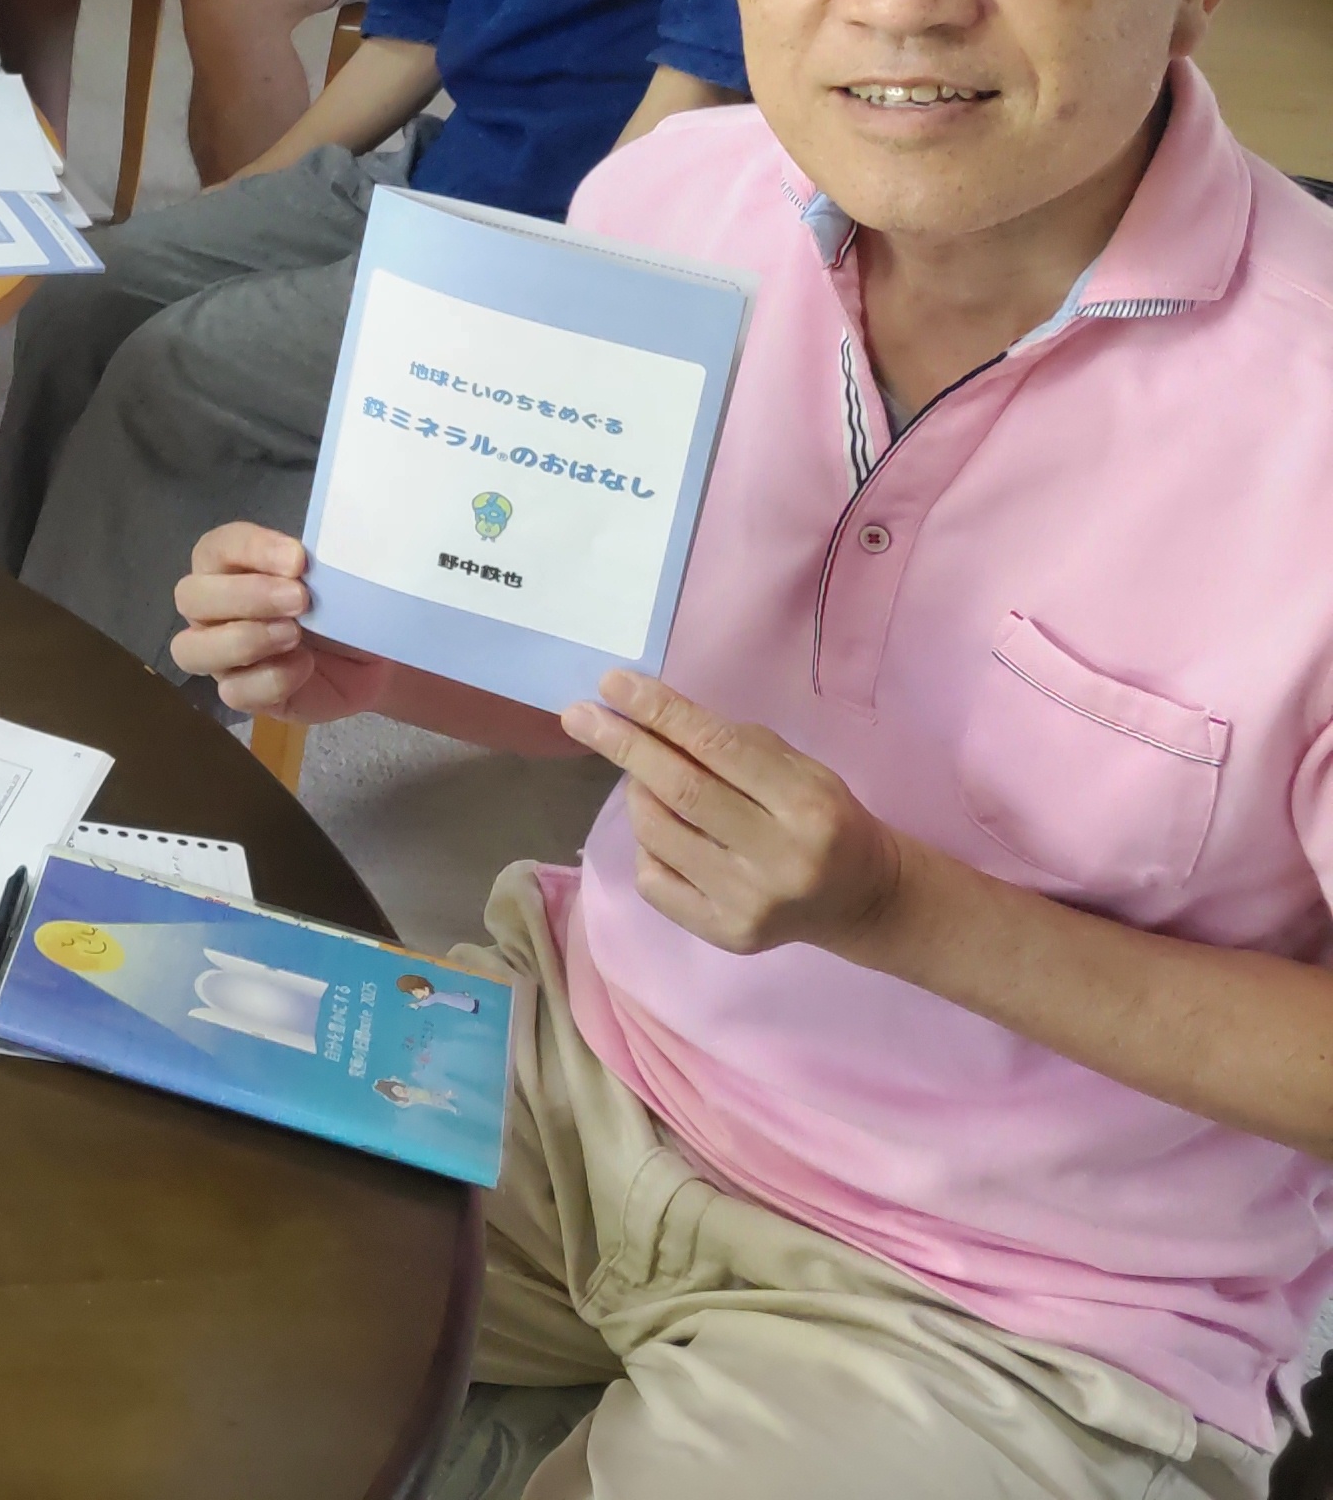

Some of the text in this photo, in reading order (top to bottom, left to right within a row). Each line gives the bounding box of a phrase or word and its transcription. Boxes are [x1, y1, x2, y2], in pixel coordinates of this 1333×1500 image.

[409, 360, 624, 436] 地球といのちをめぐる
[437, 552, 524, 590] 野中鉄也
